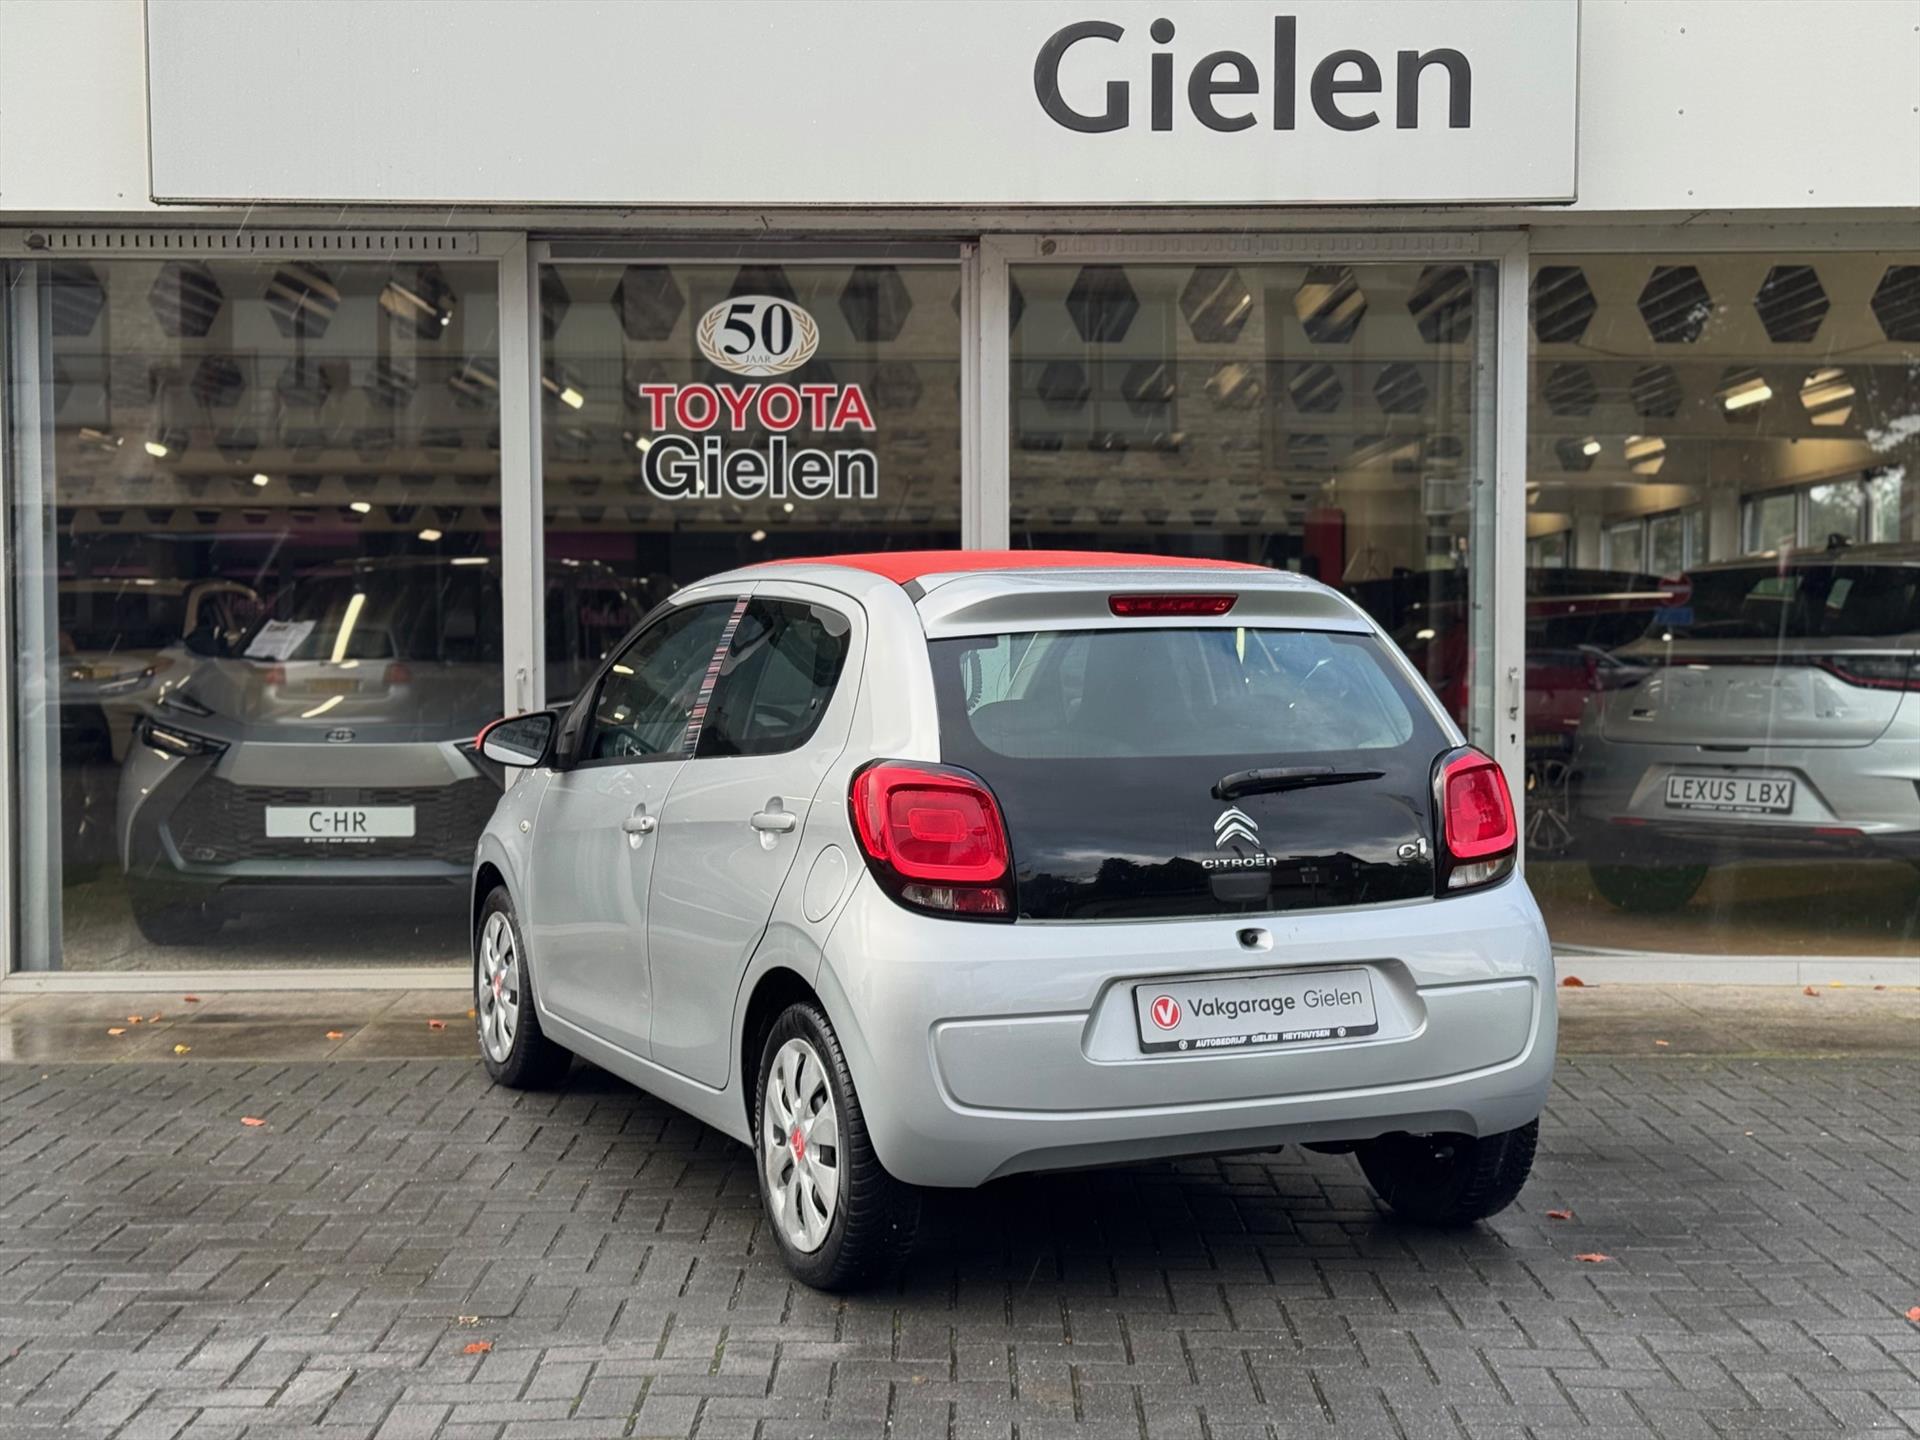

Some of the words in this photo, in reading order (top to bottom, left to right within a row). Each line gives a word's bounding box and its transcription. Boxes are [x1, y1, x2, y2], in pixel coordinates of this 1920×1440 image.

[1033, 15, 1472, 134] Gielen
[722, 303, 794, 356] 50
[744, 354, 772, 364] JAAR
[639, 383, 877, 432] TOYOTA
[642, 434, 878, 499] Gielen
[1669, 778, 1737, 802] LEXUS
[1745, 782, 1788, 805] LBX
[308, 810, 368, 833] C-HR
[1188, 993, 1296, 1020] Vakgarage
[1303, 988, 1363, 1009] Gielen
[1195, 1035, 1248, 1048] AUTOBEDRIJF
[1250, 1032, 1279, 1043] GIELEN
[1282, 1028, 1331, 1041] HEYTHUYSEN
